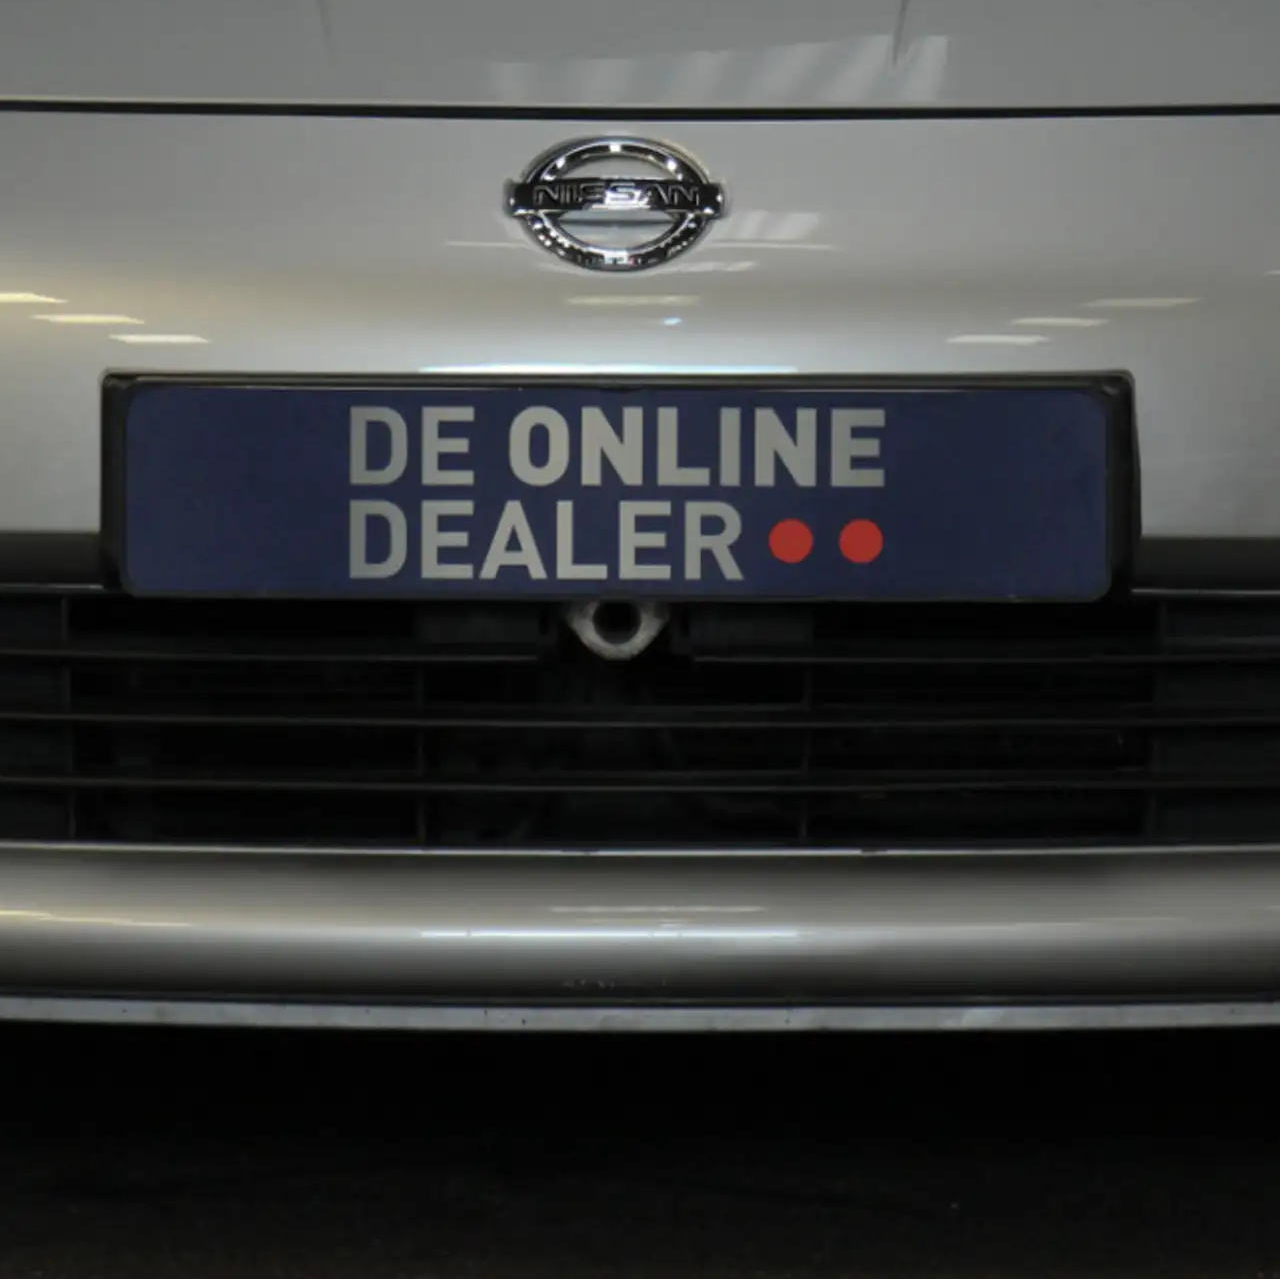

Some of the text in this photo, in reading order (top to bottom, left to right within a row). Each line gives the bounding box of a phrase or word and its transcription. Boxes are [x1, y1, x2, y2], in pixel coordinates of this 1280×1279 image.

[532, 182, 702, 209] NISSAN
[349, 405, 886, 487] DE ONLINE
[349, 499, 744, 581] DEALER
